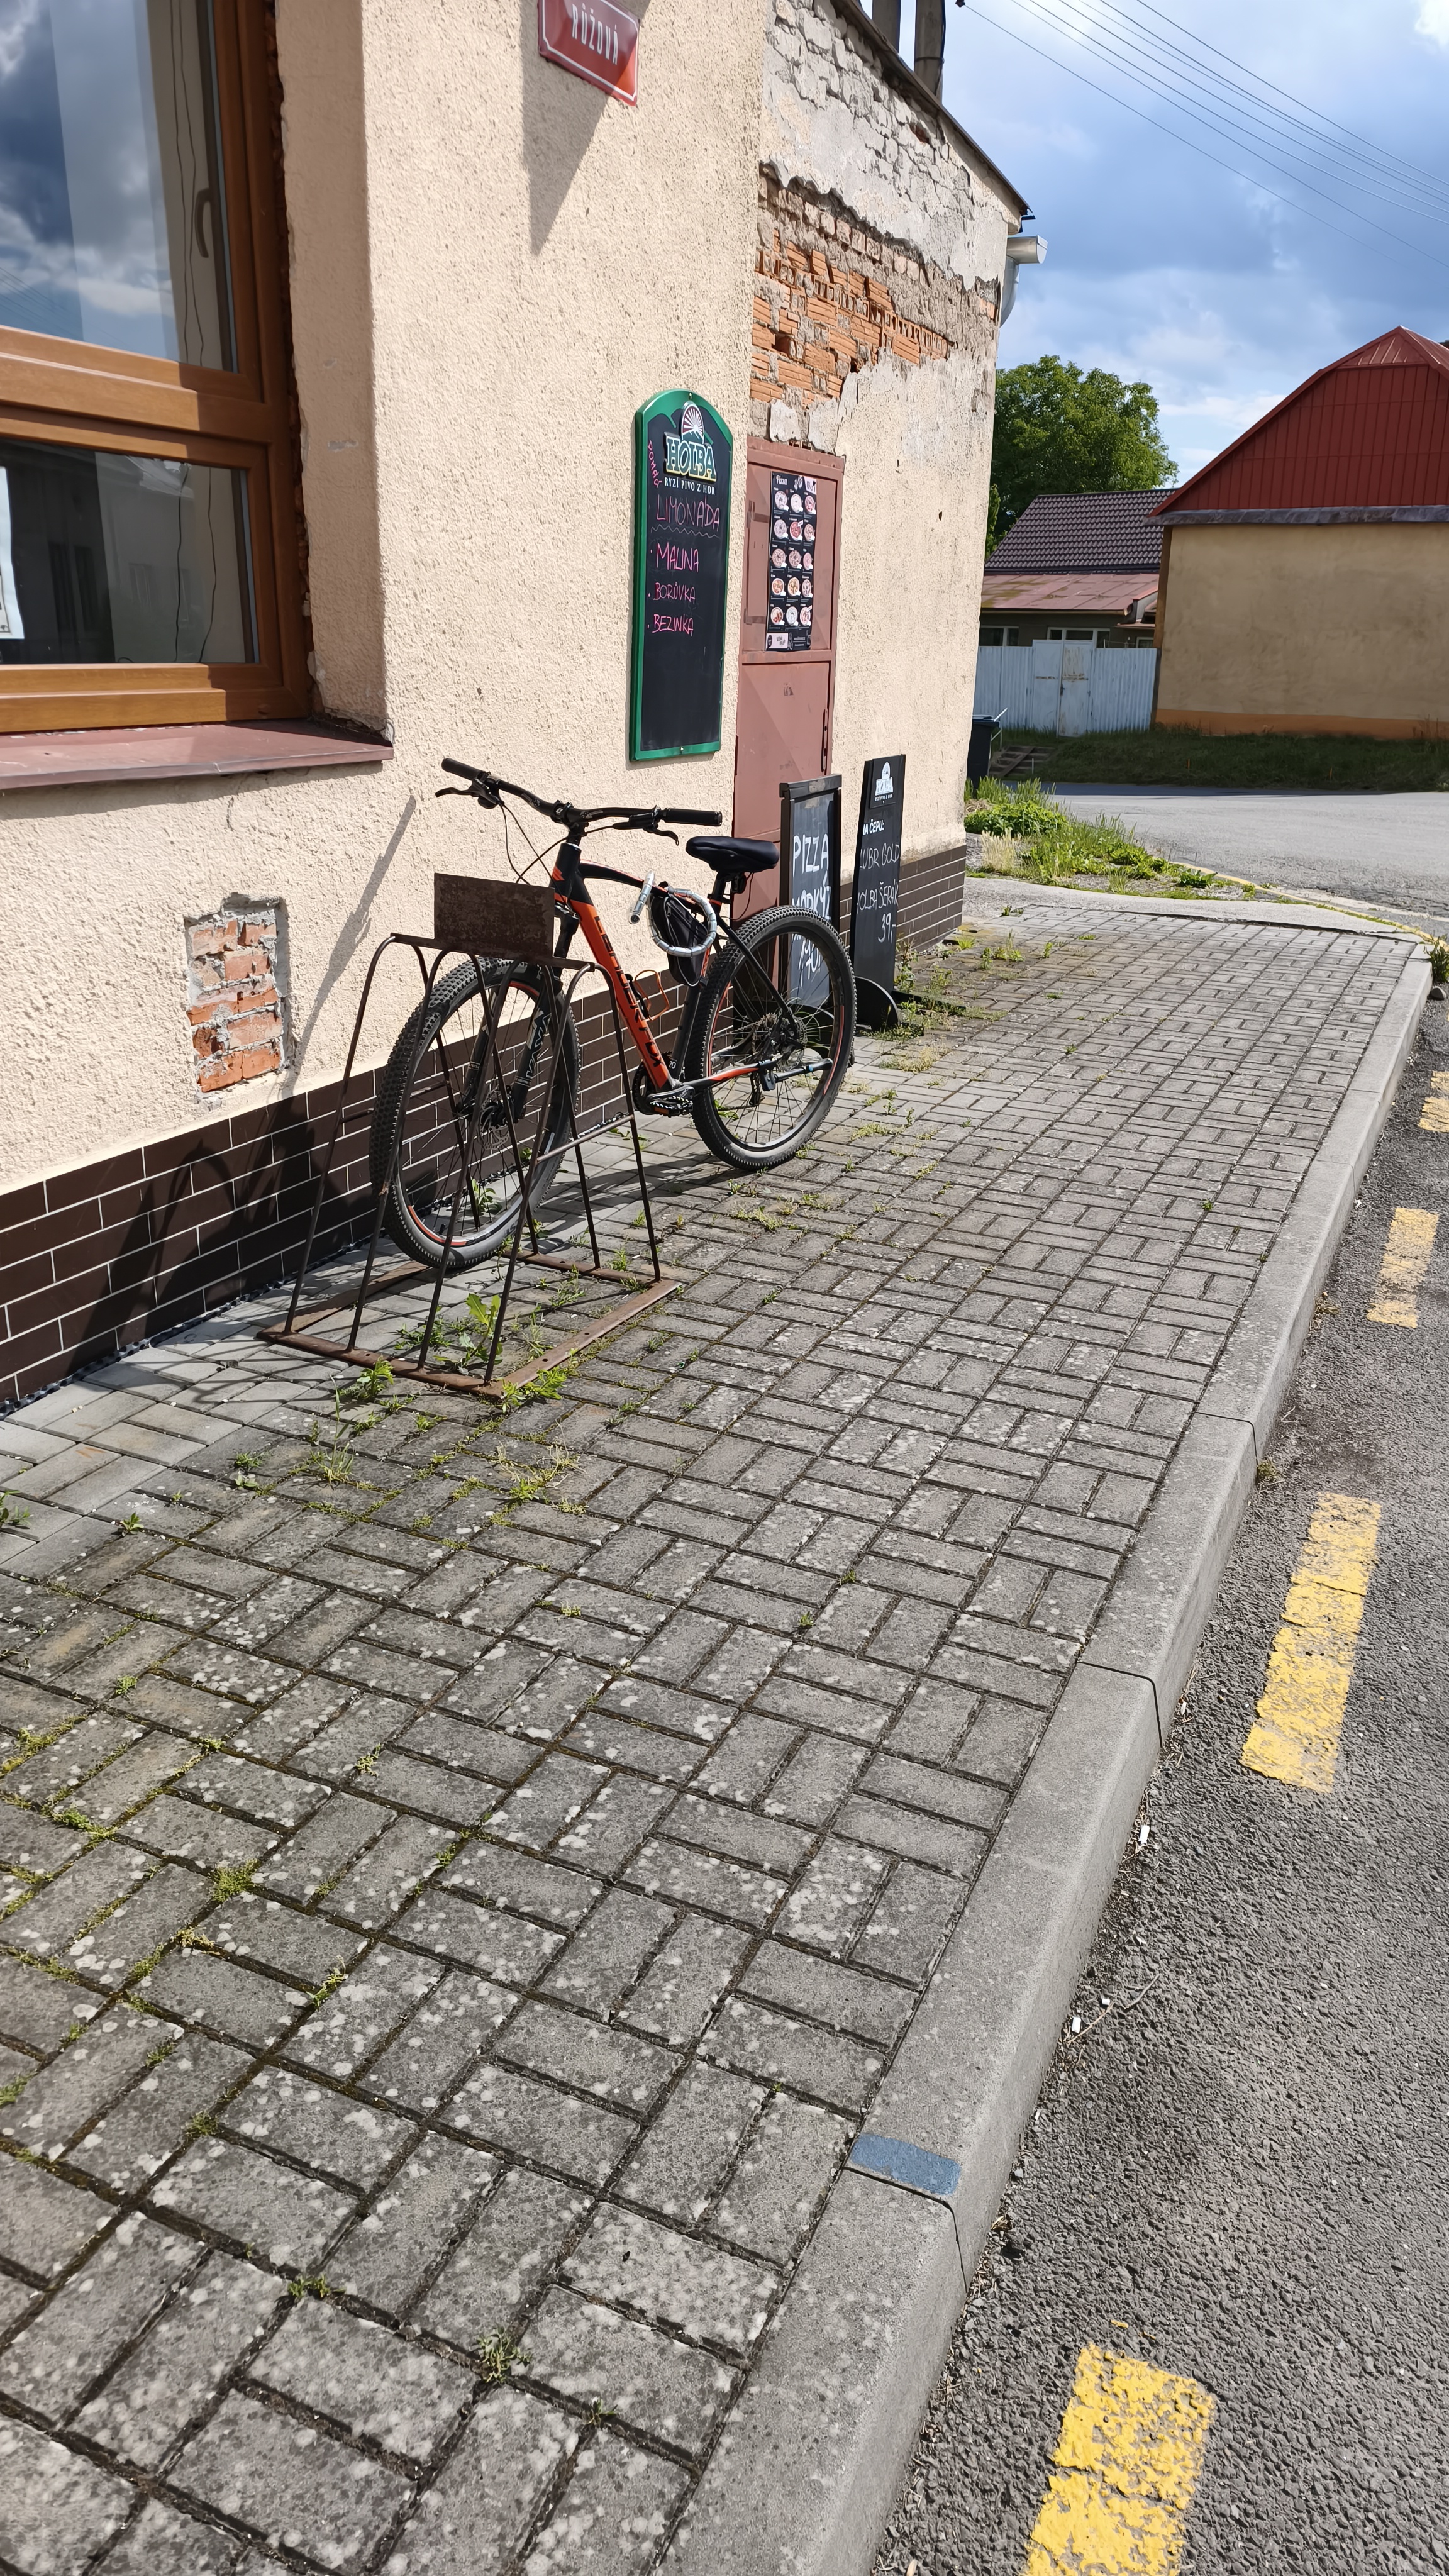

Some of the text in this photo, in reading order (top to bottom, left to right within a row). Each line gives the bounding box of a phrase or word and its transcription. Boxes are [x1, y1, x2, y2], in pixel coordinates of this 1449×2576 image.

[572, 3, 618, 65] RŮŽOVÁ
[665, 436, 717, 482] HOLBA
[664, 477, 715, 495] RYZÍ PIVO Z HOR
[657, 494, 720, 532] LIMONÁDA
[656, 541, 699, 573] MALINA
[653, 581, 696, 605] BORŮVKA
[652, 613, 694, 636] BEZINKA
[869, 819, 885, 835] ČEPU:
[792, 833, 829, 877] PIZZA
[882, 843, 900, 866] GOLD
[878, 879, 899, 908] ŠERÁK
